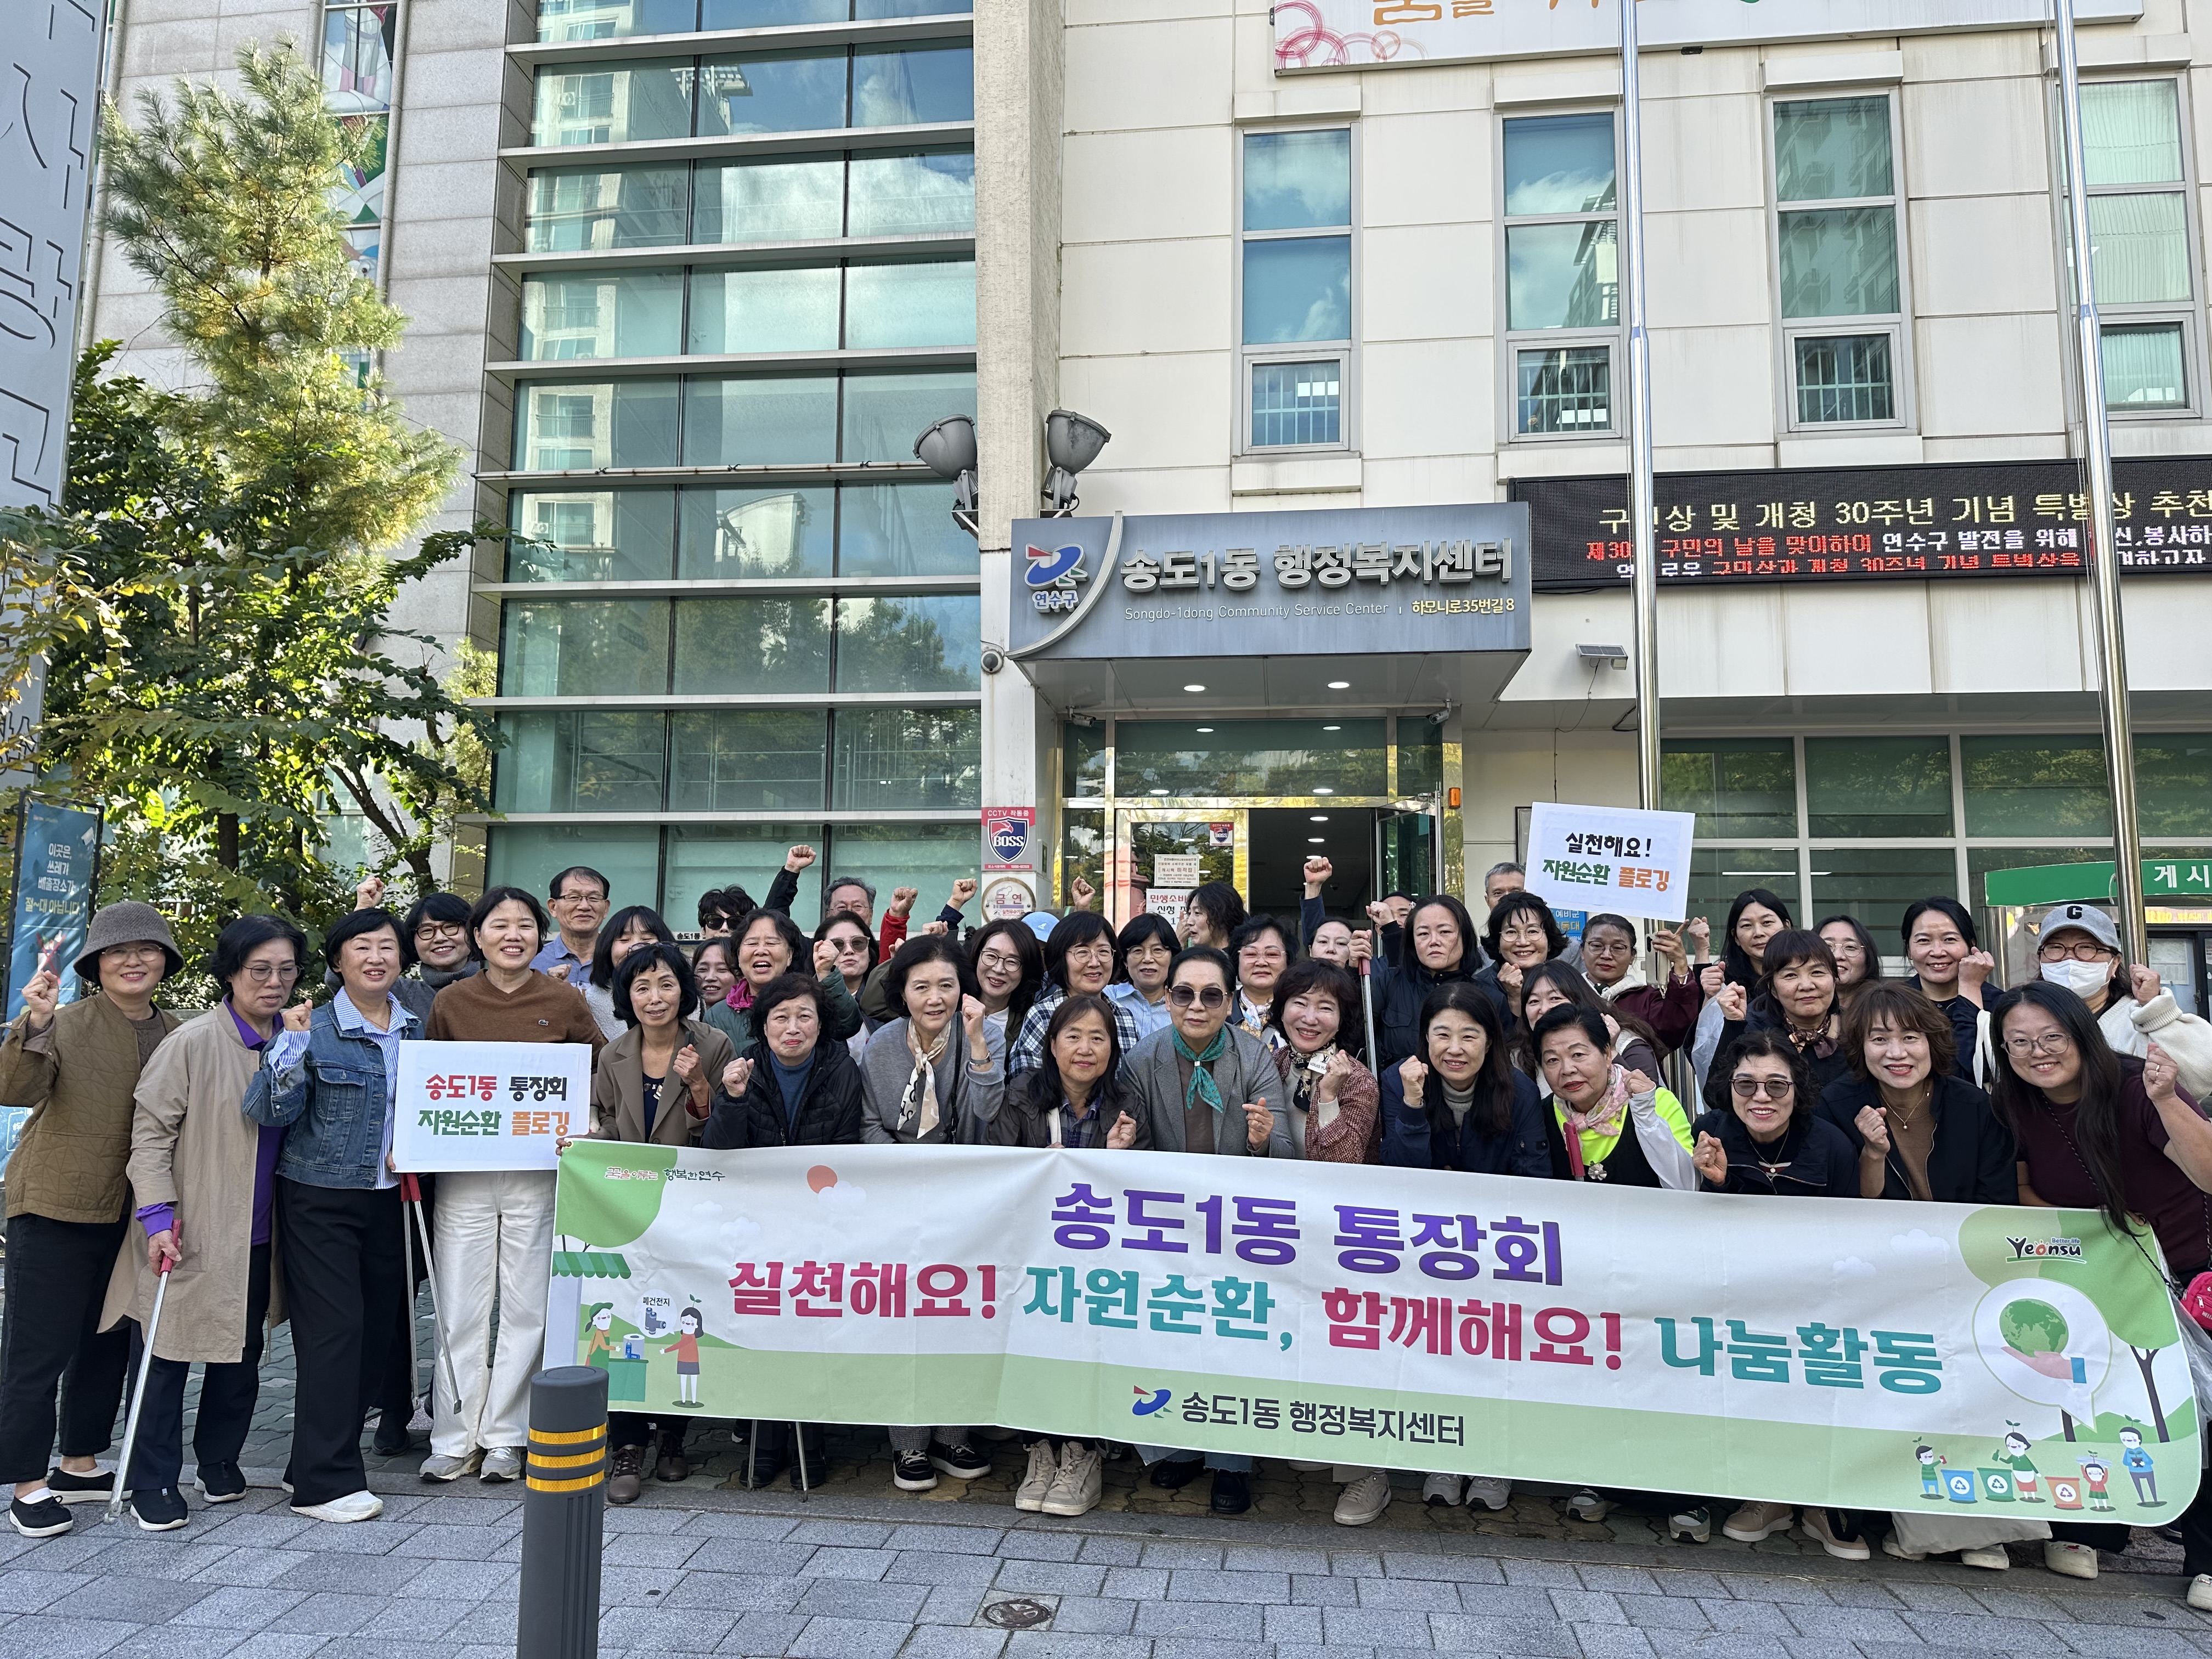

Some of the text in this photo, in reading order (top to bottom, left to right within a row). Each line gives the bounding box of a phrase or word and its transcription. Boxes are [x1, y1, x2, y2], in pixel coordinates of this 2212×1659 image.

[1711, 504, 1740, 531] 및
[1756, 501, 1815, 528] 개청
[1835, 496, 1934, 526] 30주년
[1952, 495, 2015, 523] 기념
[1586, 524, 2212, 561] 제30 구민의 날을 맞이하여 연수구 발전을 위해 신,봉사하
[1120, 537, 1512, 593] 송도1동 행정복지센터
[1032, 591, 1079, 610] 연수구
[1125, 602, 1389, 623] Songdo-1dong Community Service Center
[1412, 598, 1515, 616] 하모니로35번길 8
[48, 843, 72, 860] 이곳은,
[994, 836, 1024, 847] BOSS
[1565, 832, 1651, 858] 실천해요!
[1542, 859, 1670, 892] 자원순환 플로깅
[1157, 905, 1175, 915] 신청
[425, 1073, 568, 1102] 송도1동 통장회
[417, 1109, 570, 1136] 자원순환 플로깅
[1051, 1182, 1563, 1286] 송도1동 통장회
[2006, 1235, 2081, 1260] Yeonsu
[642, 1296, 670, 1307] 폐건전지
[727, 1260, 1944, 1395] 실천해요! 자원순환, 함께해요! 나눔활동
[1181, 1392, 1464, 1447] 송도1동 행정복지센터
